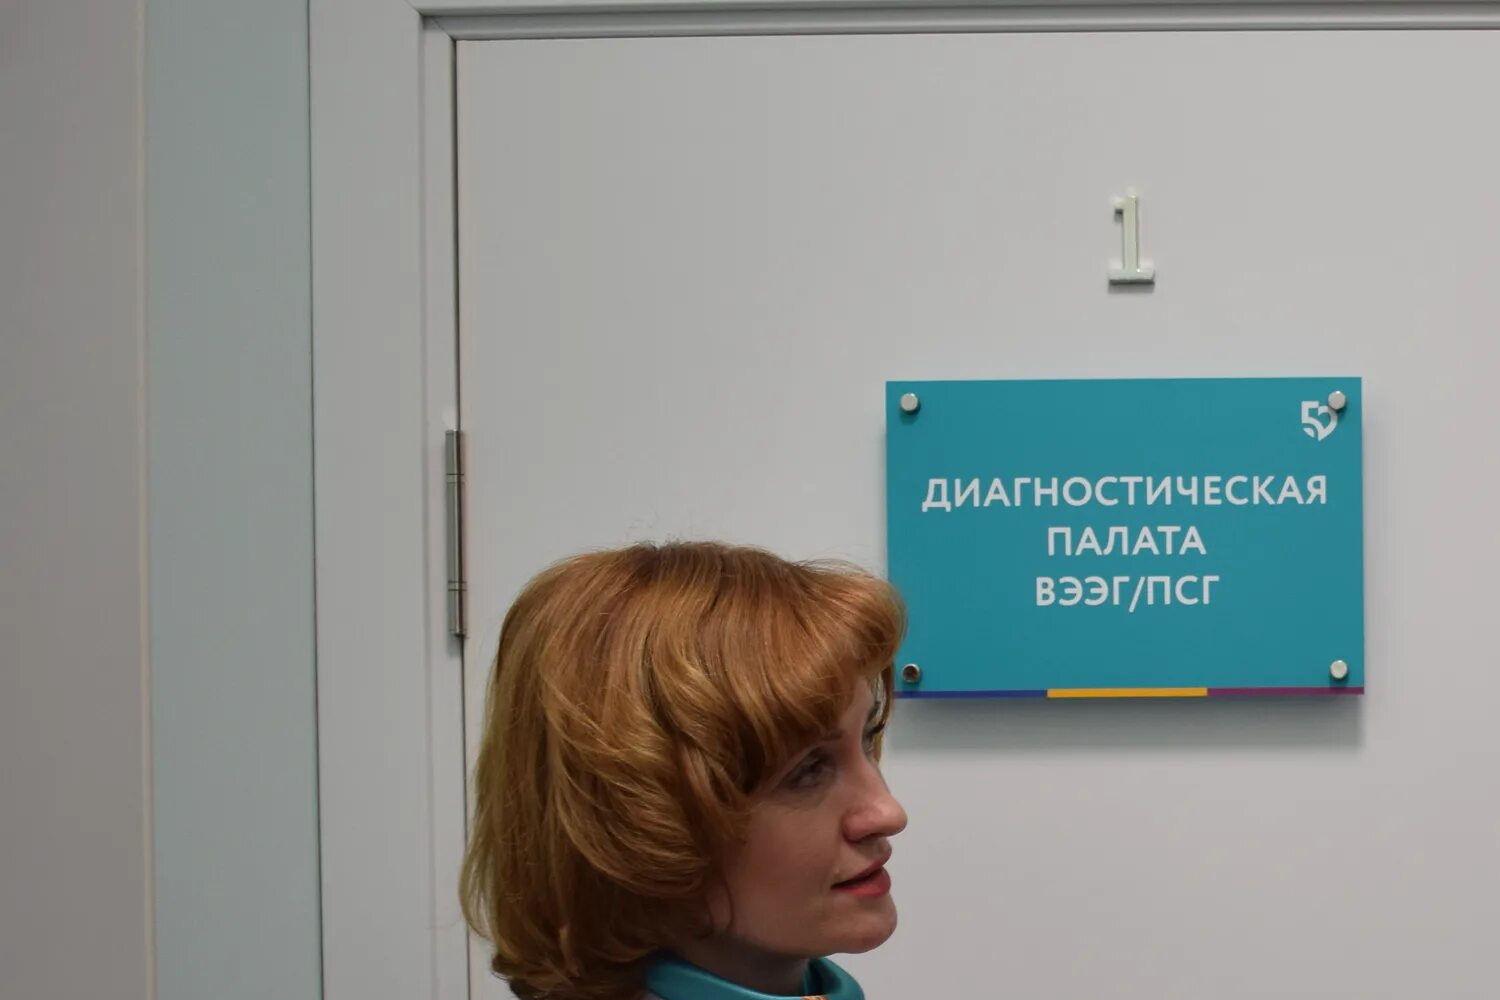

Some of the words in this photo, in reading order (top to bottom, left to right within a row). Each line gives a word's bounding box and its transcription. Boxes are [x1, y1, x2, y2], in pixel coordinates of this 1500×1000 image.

[1107, 194, 1155, 286] 1
[921, 475, 1328, 513] ДИАГНОСТИЧЕСКАЯ
[1047, 525, 1207, 557] ПАЛАТА
[1035, 575, 1220, 613] ВЭЭГ/ПСГ
